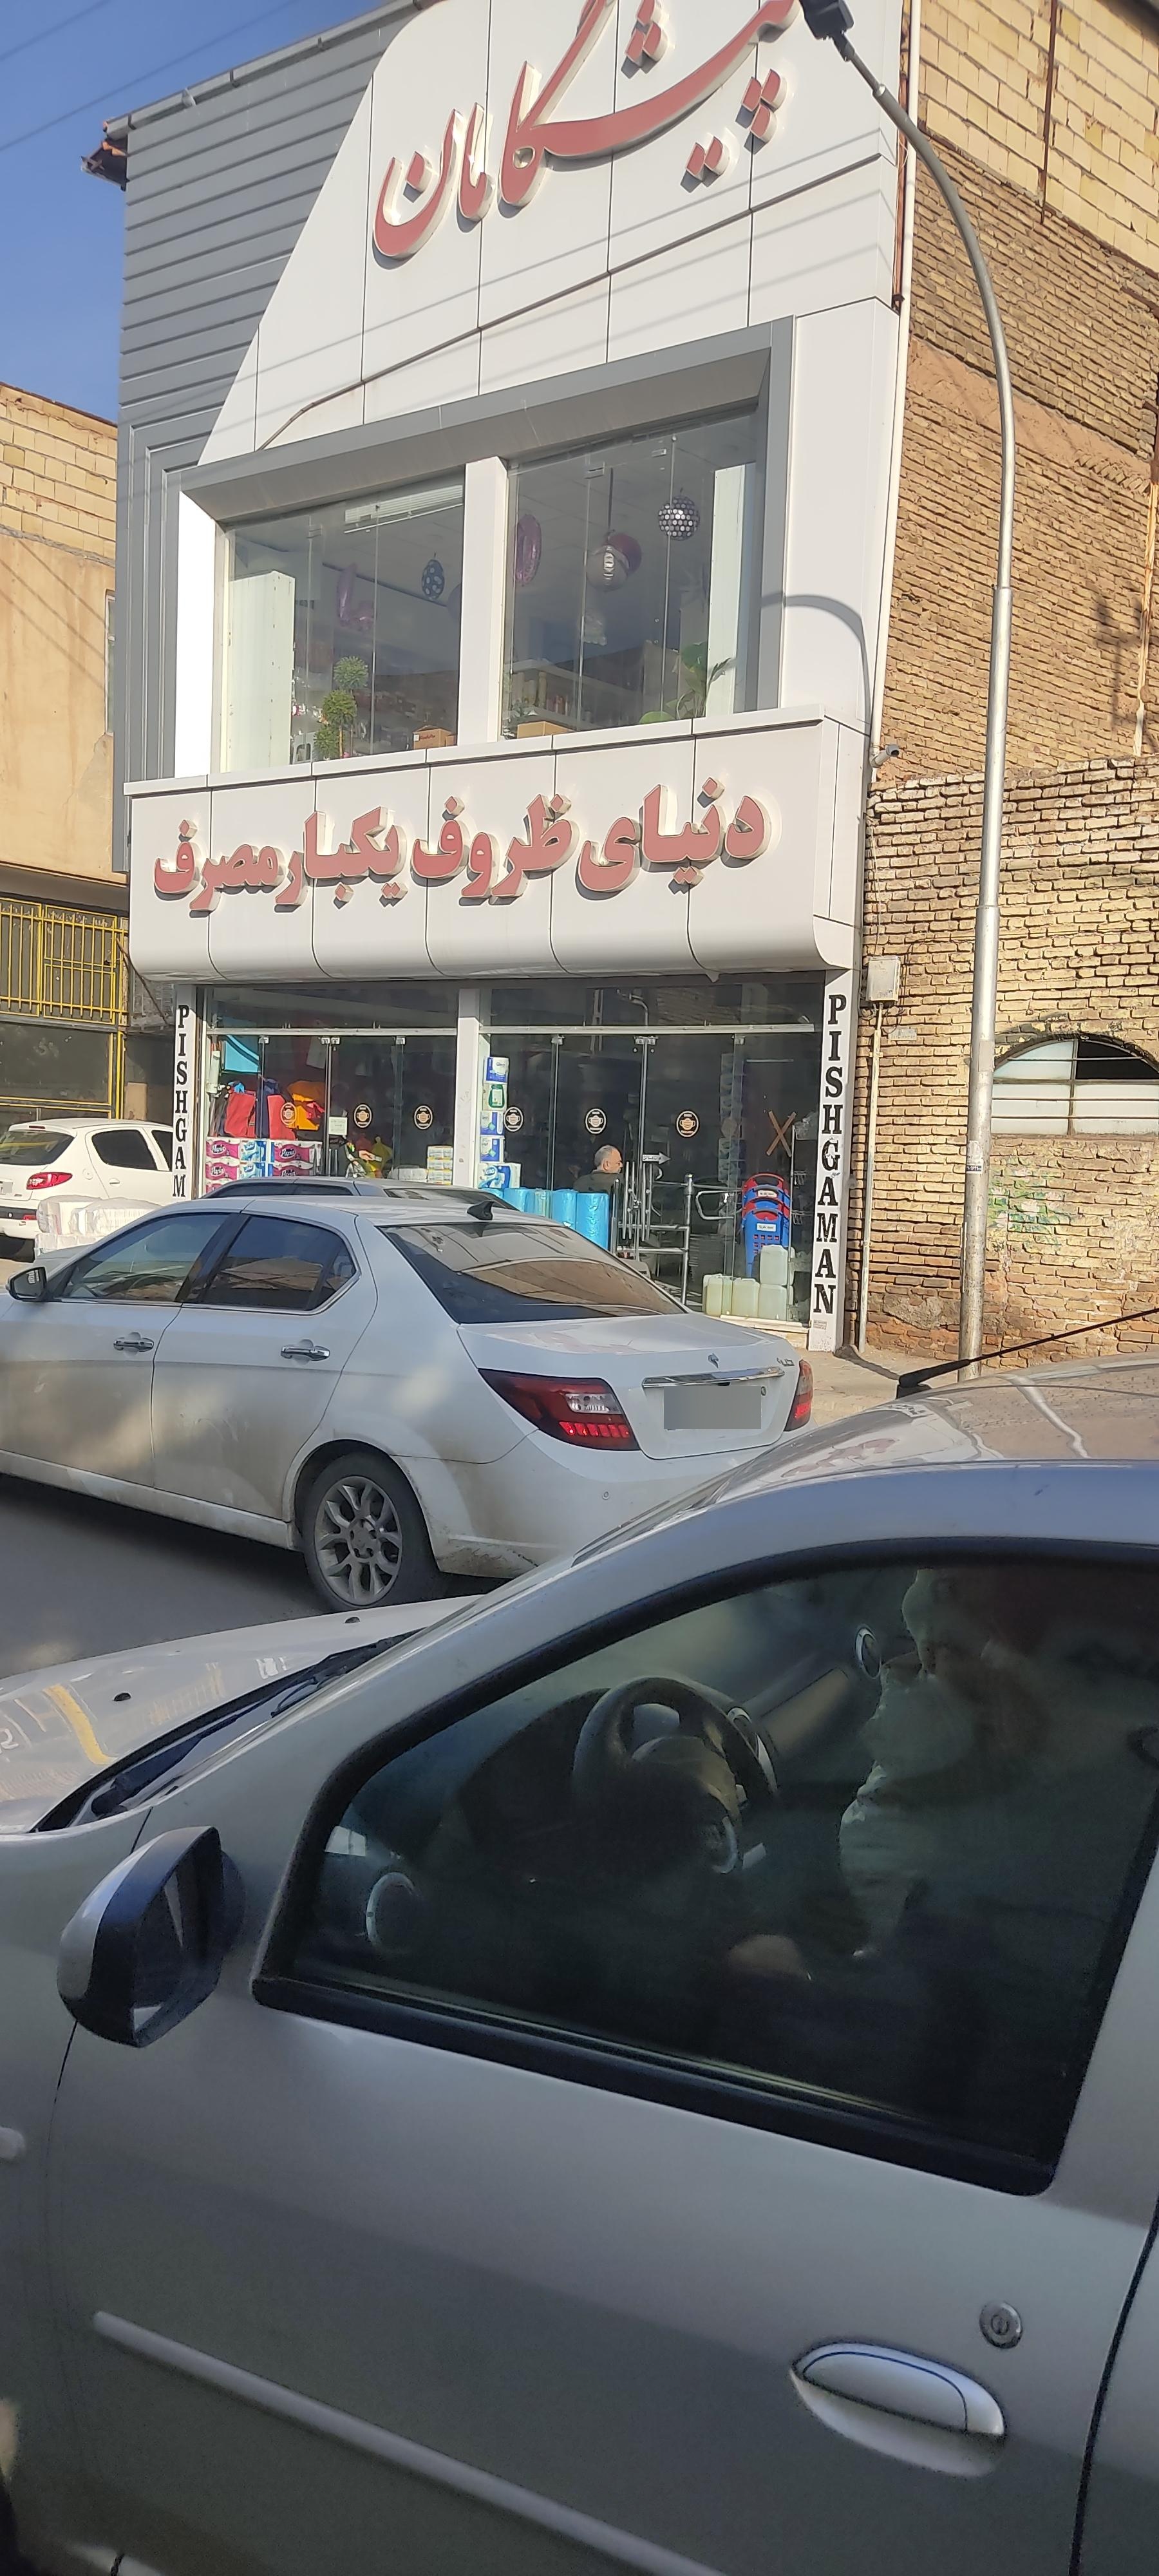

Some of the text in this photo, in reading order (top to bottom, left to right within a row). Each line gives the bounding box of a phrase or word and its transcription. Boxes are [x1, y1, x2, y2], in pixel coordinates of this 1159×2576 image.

[411, 795, 572, 898] ظروف
[578, 777, 770, 892] دنیای
[813, 994, 847, 1314] PISHGAMAN
